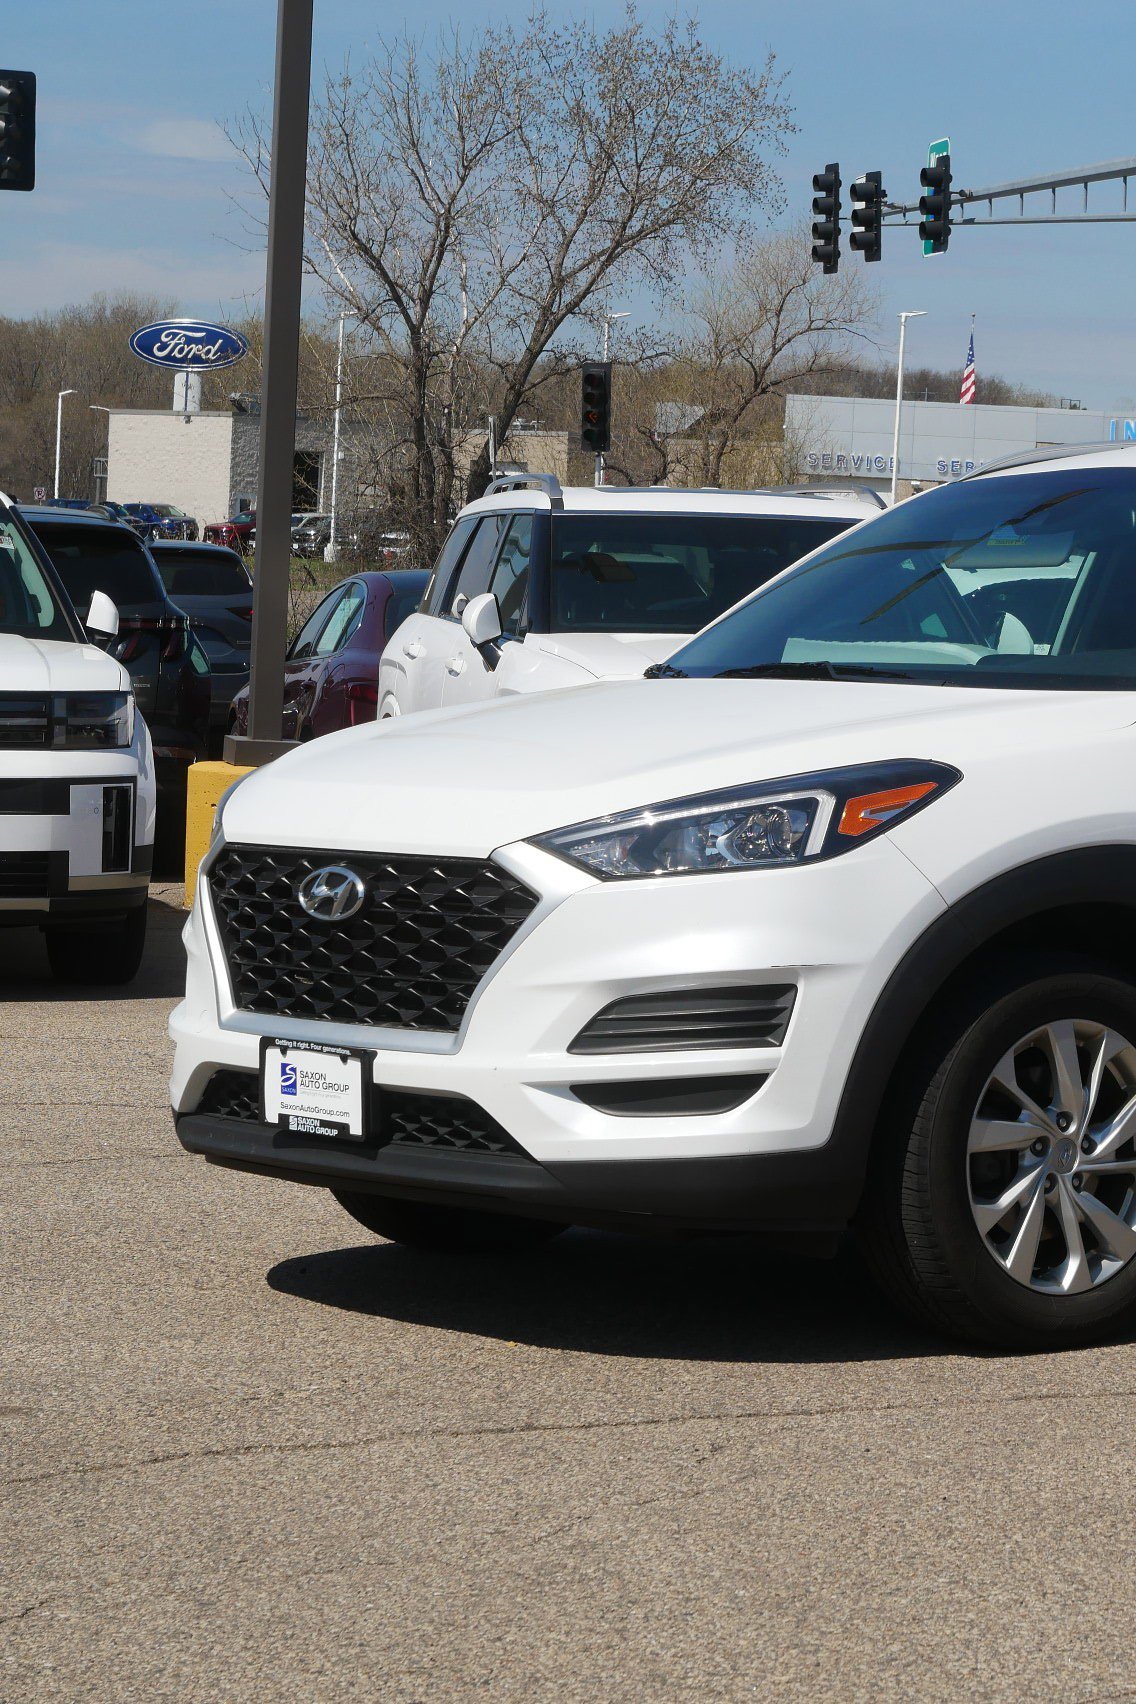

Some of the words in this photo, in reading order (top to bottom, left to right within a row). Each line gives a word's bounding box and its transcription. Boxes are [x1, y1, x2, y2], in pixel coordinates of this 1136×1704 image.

[153, 329, 223, 360] Ford
[310, 1043, 322, 1051] Four
[300, 1070, 327, 1082] SAXON
[300, 1079, 321, 1090] AUTO
[322, 1082, 350, 1093] GROUP
[280, 1101, 351, 1117] SaxonAutoGroup.com
[298, 1116, 321, 1127] SAXON
[297, 1123, 316, 1133] AUTO
[315, 1126, 339, 1137] GROUP
